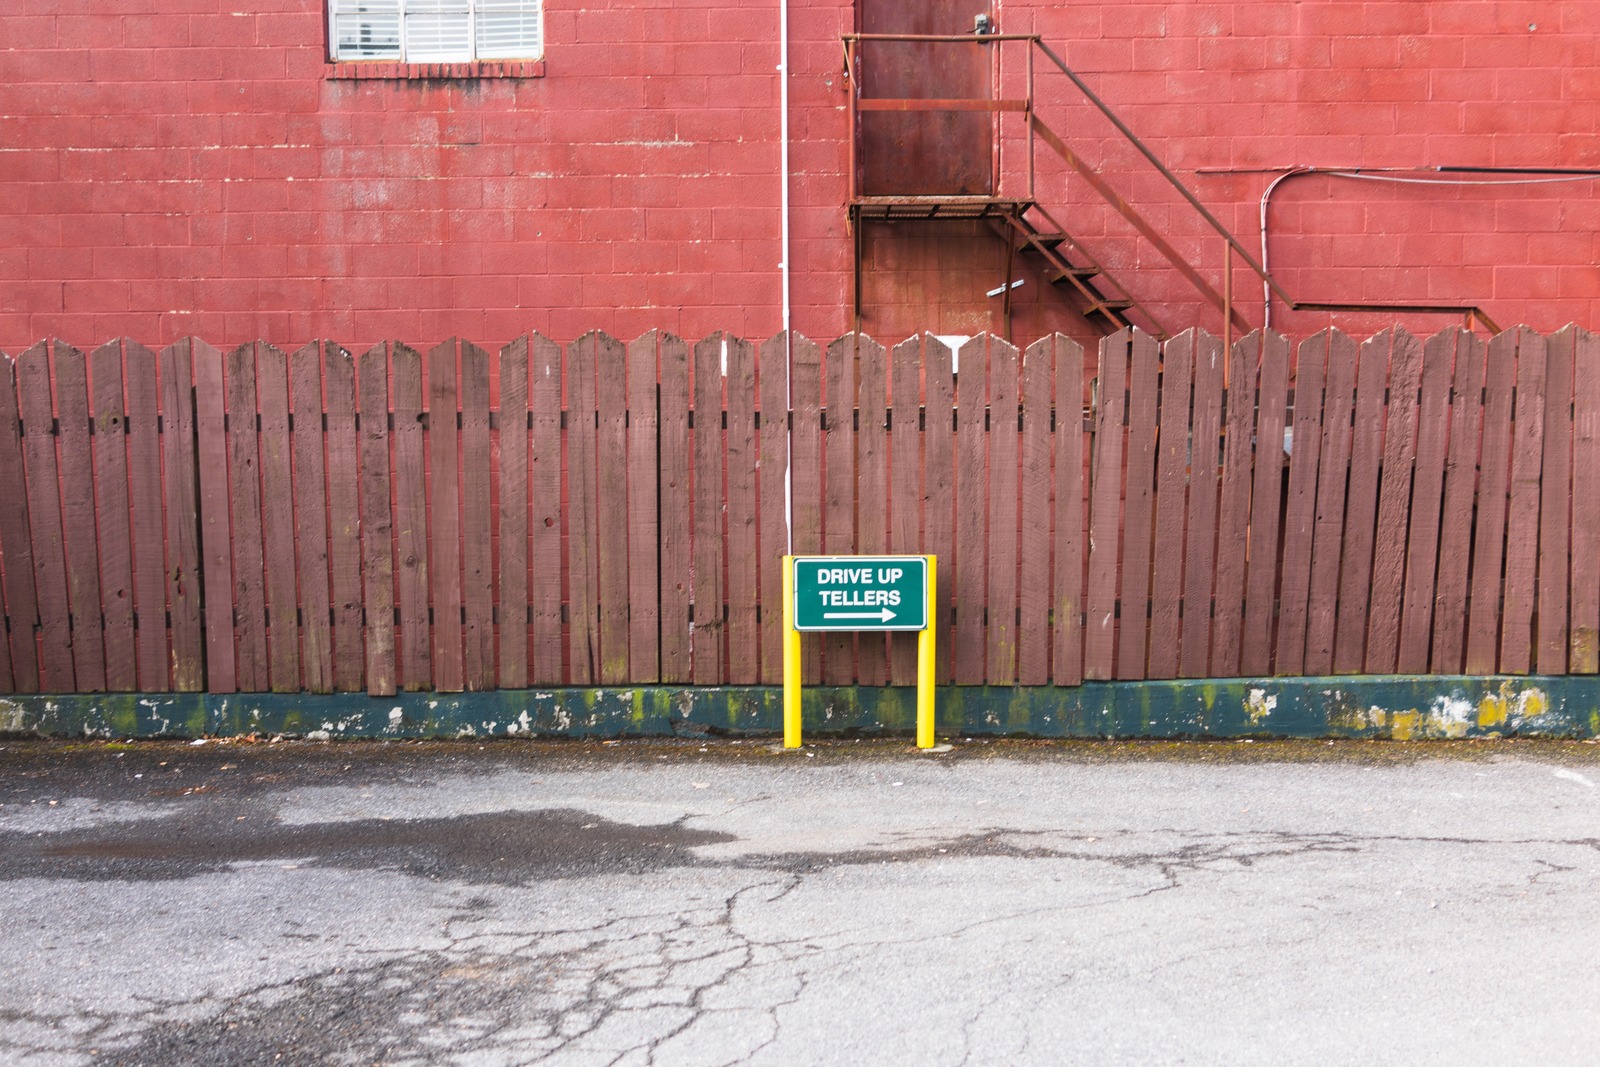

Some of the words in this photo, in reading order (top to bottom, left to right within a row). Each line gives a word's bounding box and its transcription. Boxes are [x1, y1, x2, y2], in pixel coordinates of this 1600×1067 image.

[817, 568, 873, 584] DRIVE
[877, 568, 903, 584] UP
[818, 590, 901, 606] TELLERS
